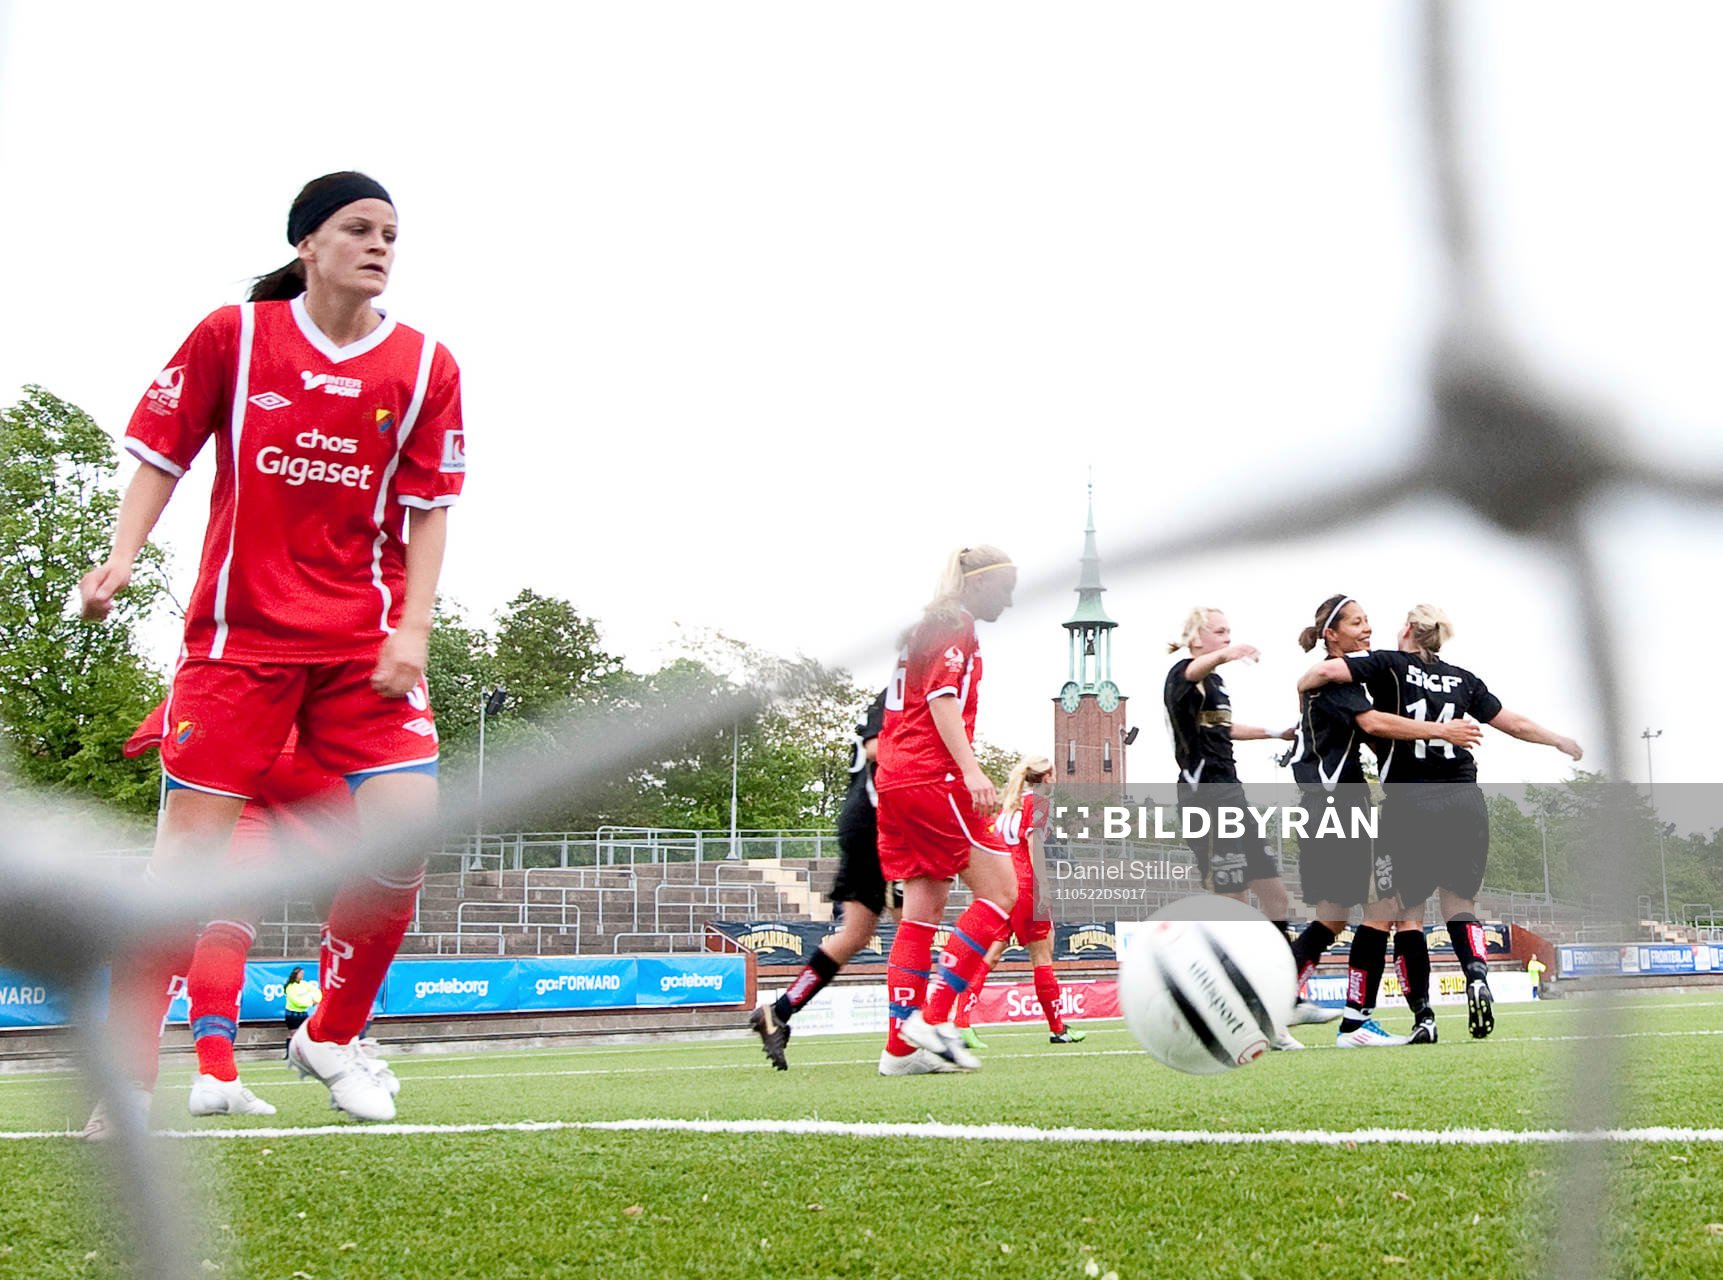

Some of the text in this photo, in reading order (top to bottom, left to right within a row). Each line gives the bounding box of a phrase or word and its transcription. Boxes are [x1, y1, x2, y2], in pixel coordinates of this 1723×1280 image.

[295, 428, 359, 454] chos
[256, 445, 374, 490] Gigaset
[1405, 698, 1456, 759] 14
[1006, 987, 1085, 1017] Scadic
